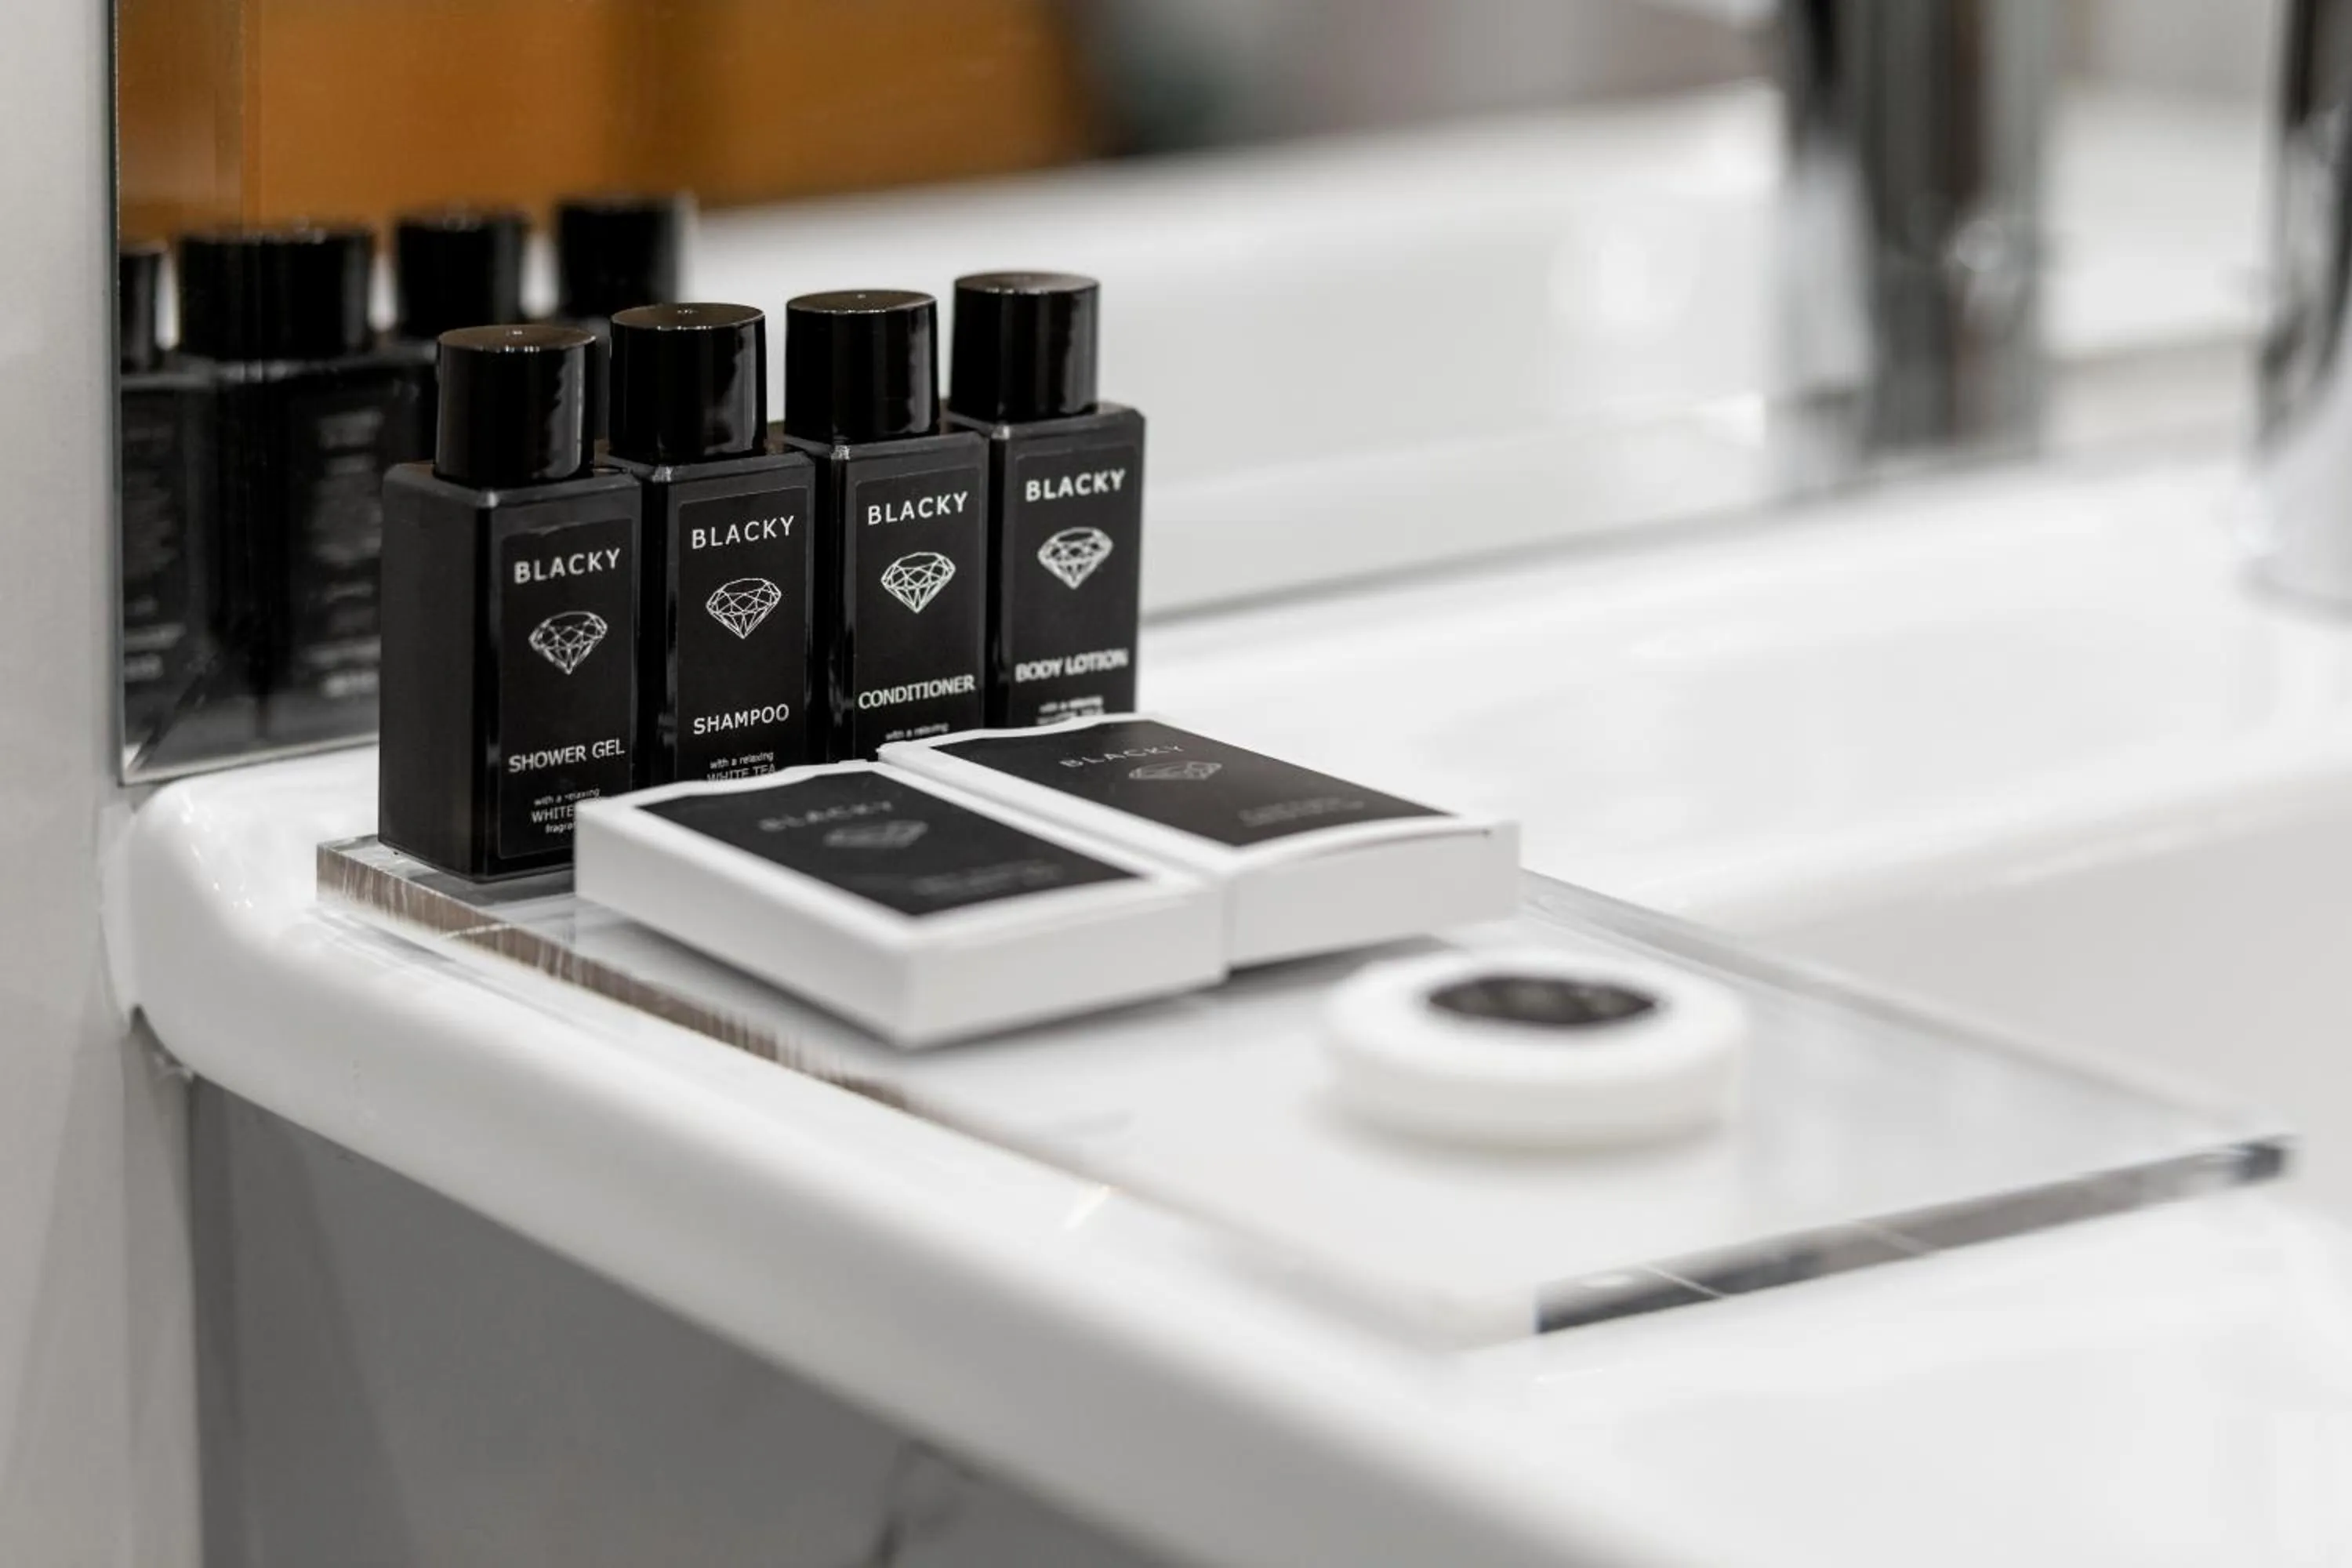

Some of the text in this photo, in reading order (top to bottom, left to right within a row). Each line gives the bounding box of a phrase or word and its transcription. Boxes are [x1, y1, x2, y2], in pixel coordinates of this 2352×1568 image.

[1025, 469, 1126, 502] BLACKY
[867, 491, 968, 525] BLACKY
[691, 514, 794, 550] BLACKY
[514, 547, 620, 584] BLACKY
[1014, 648, 1129, 683] BODY LOTION
[858, 674, 975, 709] CONDITIONER
[693, 703, 789, 735] SHAMPOO
[508, 737, 626, 773] SHOWER GEL
[1058, 744, 1185, 768] BLACKY
[531, 804, 575, 823] WHITE
